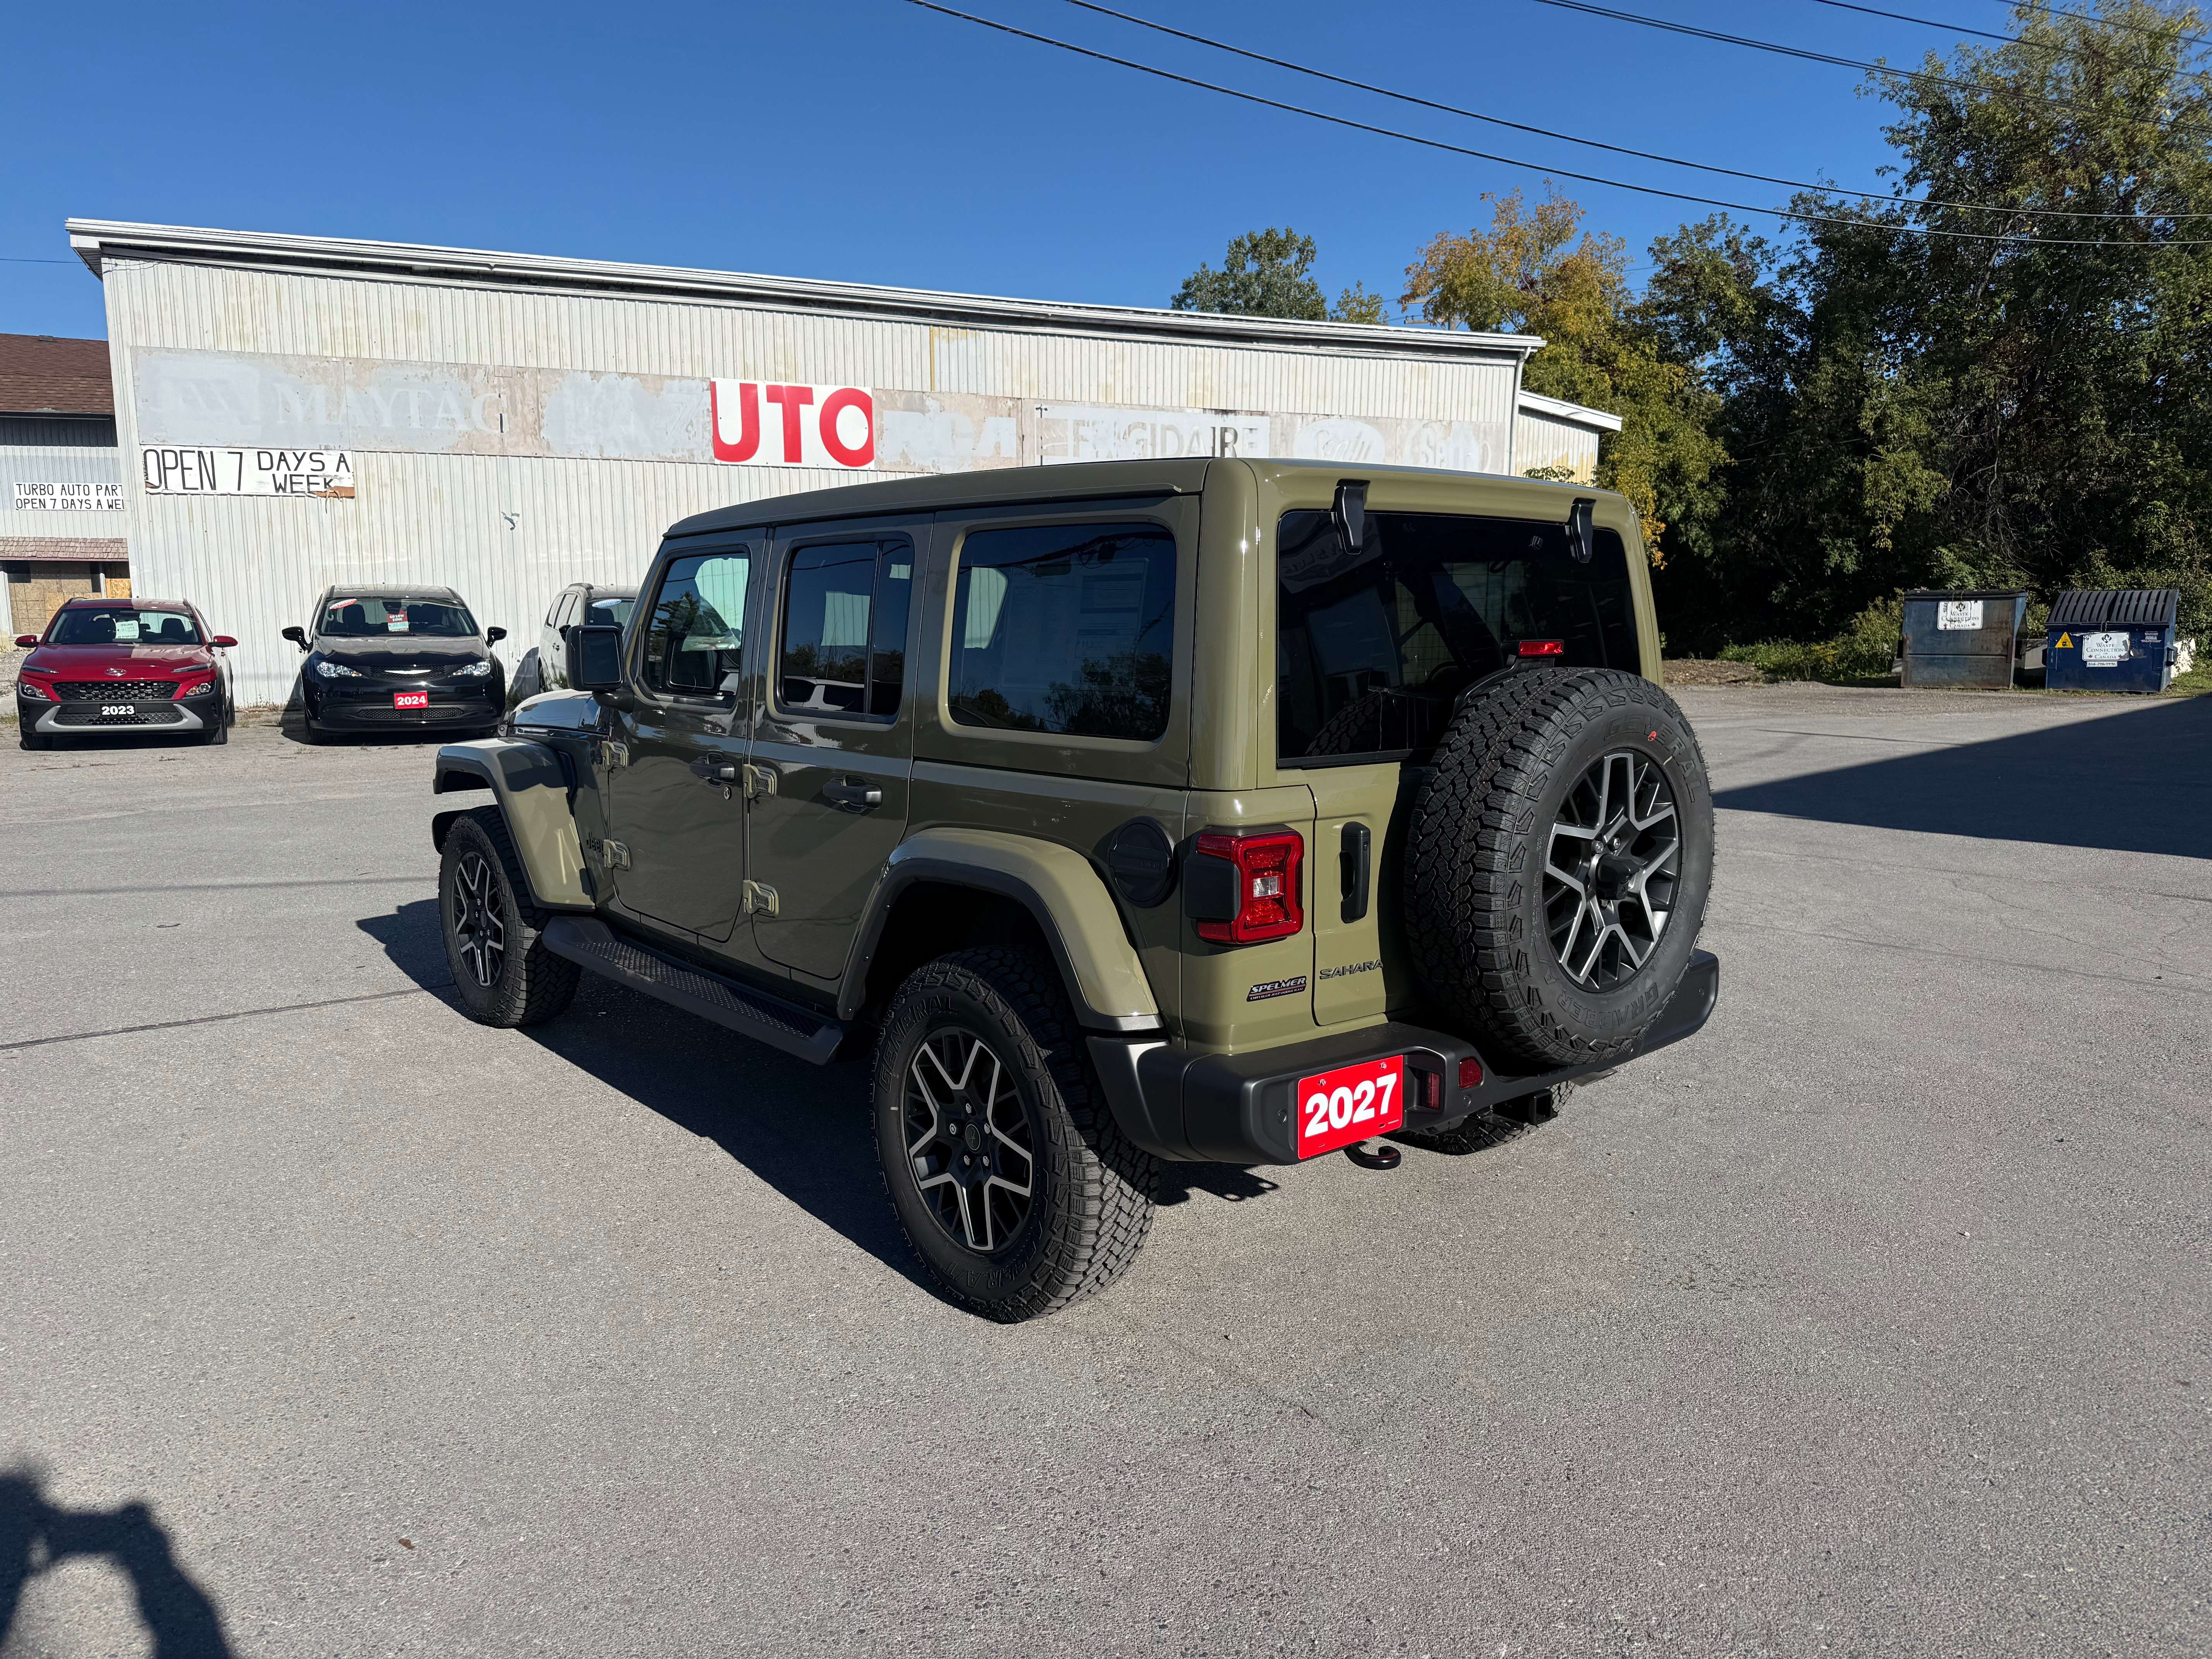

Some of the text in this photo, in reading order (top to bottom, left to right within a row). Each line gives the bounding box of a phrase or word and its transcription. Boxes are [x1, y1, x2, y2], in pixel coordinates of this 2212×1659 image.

[710, 381, 874, 467] UTO
[1073, 420, 1258, 457] FGIDAIRE
[143, 449, 350, 491] OPEN 7 DAYS A
[272, 474, 334, 493] WEEK
[16, 484, 54, 495] TURBO
[61, 484, 90, 496] AUTO
[16, 498, 124, 509] OPEN 7 DAYS A WE
[101, 706, 134, 715] 2023
[397, 696, 426, 705] 2024
[1604, 714, 1702, 803] GENERAL
[1319, 959, 1384, 979] SAHARA
[1251, 978, 1306, 993] SPELMER
[1557, 982, 1659, 1029] GRABBER
[879, 995, 959, 1092] GENERAL
[1305, 1073, 1397, 1137] 2027
